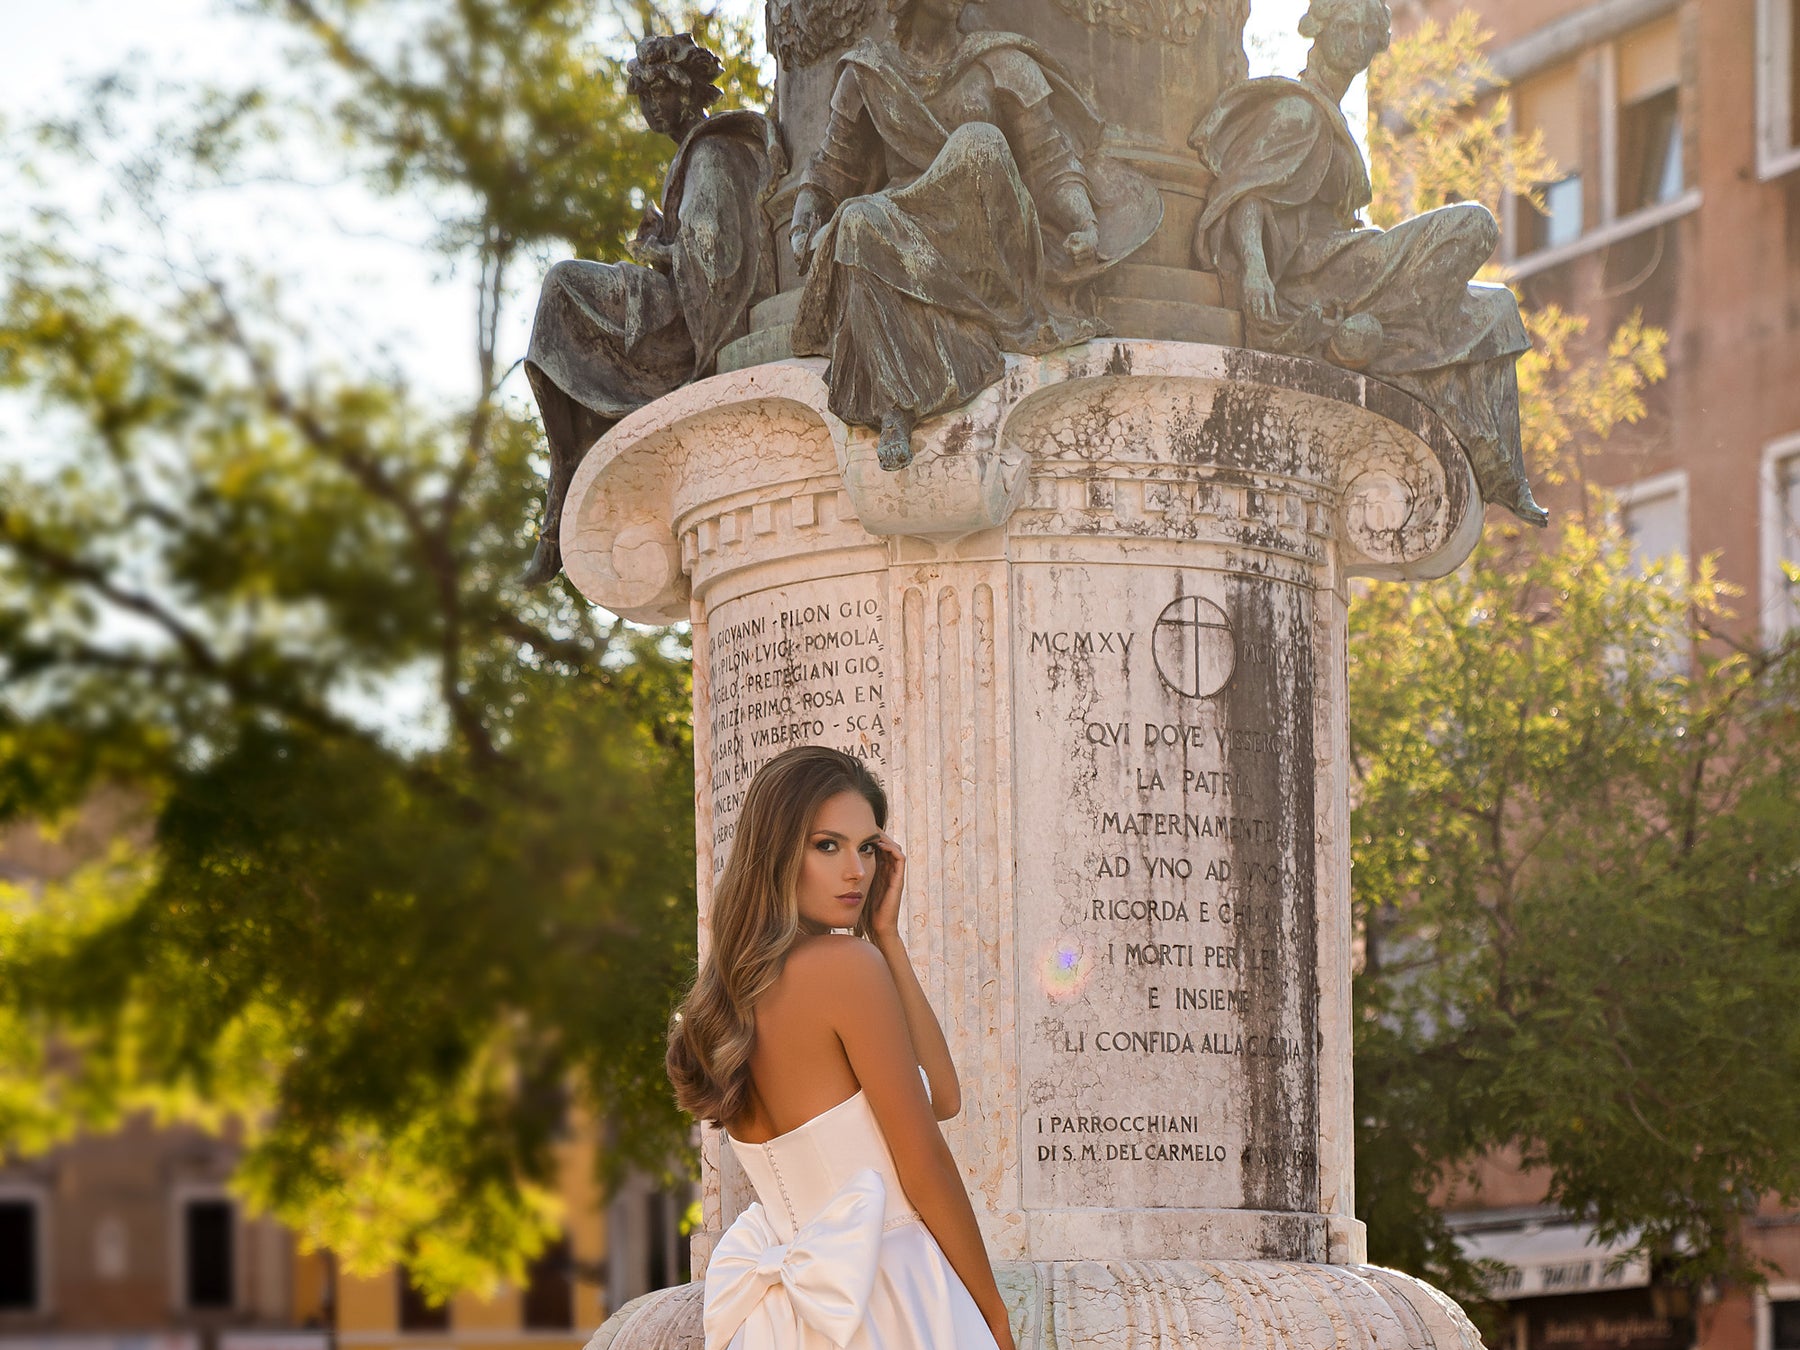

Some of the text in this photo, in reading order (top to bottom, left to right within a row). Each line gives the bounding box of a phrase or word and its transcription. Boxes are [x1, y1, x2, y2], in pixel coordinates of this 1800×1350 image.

[717, 616, 765, 648] GIOVANNI
[780, 604, 830, 629] PILON
[1030, 631, 1135, 653] MCMXV
[721, 647, 750, 676] PILON
[720, 705, 744, 732] RIZZI
[747, 698, 792, 721] PRIMO
[803, 689, 845, 710] ROSA
[751, 719, 825, 749] VMBERTO
[1085, 722, 1284, 754] QVI DOVE VISSERO
[1136, 767, 1253, 799] LA PATRIA
[1101, 811, 1273, 843] MATERNAMENTE
[1097, 856, 1279, 886] AD VNO AD VNO
[1092, 899, 1190, 923] RICORDA
[1199, 902, 1210, 923] E
[1107, 943, 1114, 965] I
[1125, 943, 1194, 967] MORTI
[1204, 945, 1241, 969] PER
[1148, 986, 1250, 1013] E INSIEME
[1065, 1030, 1085, 1052] LI
[1095, 1031, 1195, 1054] CONFIDA
[1201, 1032, 1243, 1055] ALLA
[1037, 1115, 1199, 1134] I PARROCCHIANI
[1037, 1144, 1057, 1162] DI
[1062, 1144, 1077, 1162] S.
[1106, 1143, 1143, 1162] DEL
[1145, 1144, 1228, 1162] CARMELO
